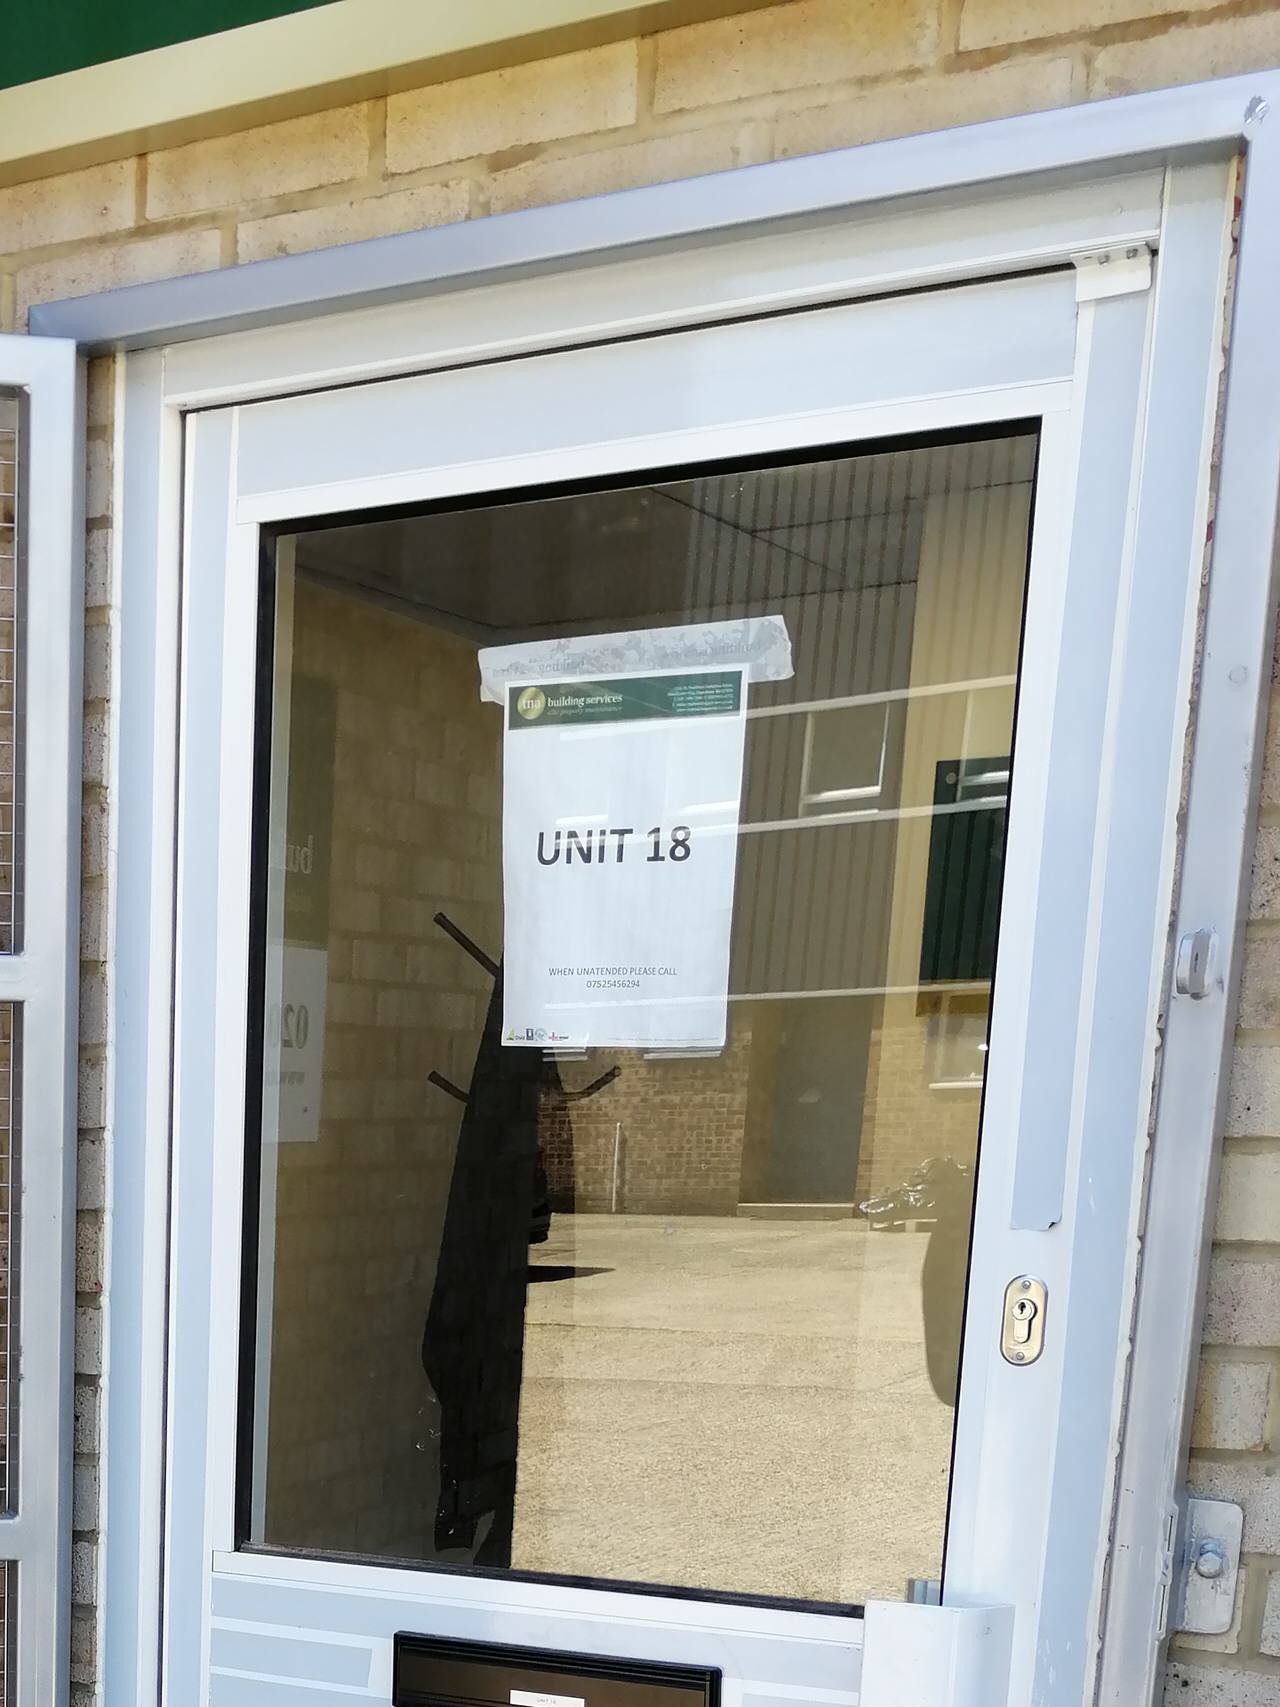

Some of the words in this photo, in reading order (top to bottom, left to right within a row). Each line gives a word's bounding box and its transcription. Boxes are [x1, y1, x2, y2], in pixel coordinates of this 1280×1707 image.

[547, 695, 585, 708] building
[585, 694, 623, 705] services
[537, 828, 634, 866] UNIT
[646, 825, 692, 862] 18
[548, 967, 575, 977] WHEN
[576, 966, 628, 976] UNATENDED
[629, 966, 657, 976] PLEASE
[657, 967, 678, 976] CALL
[586, 979, 640, 989] 07525456294
